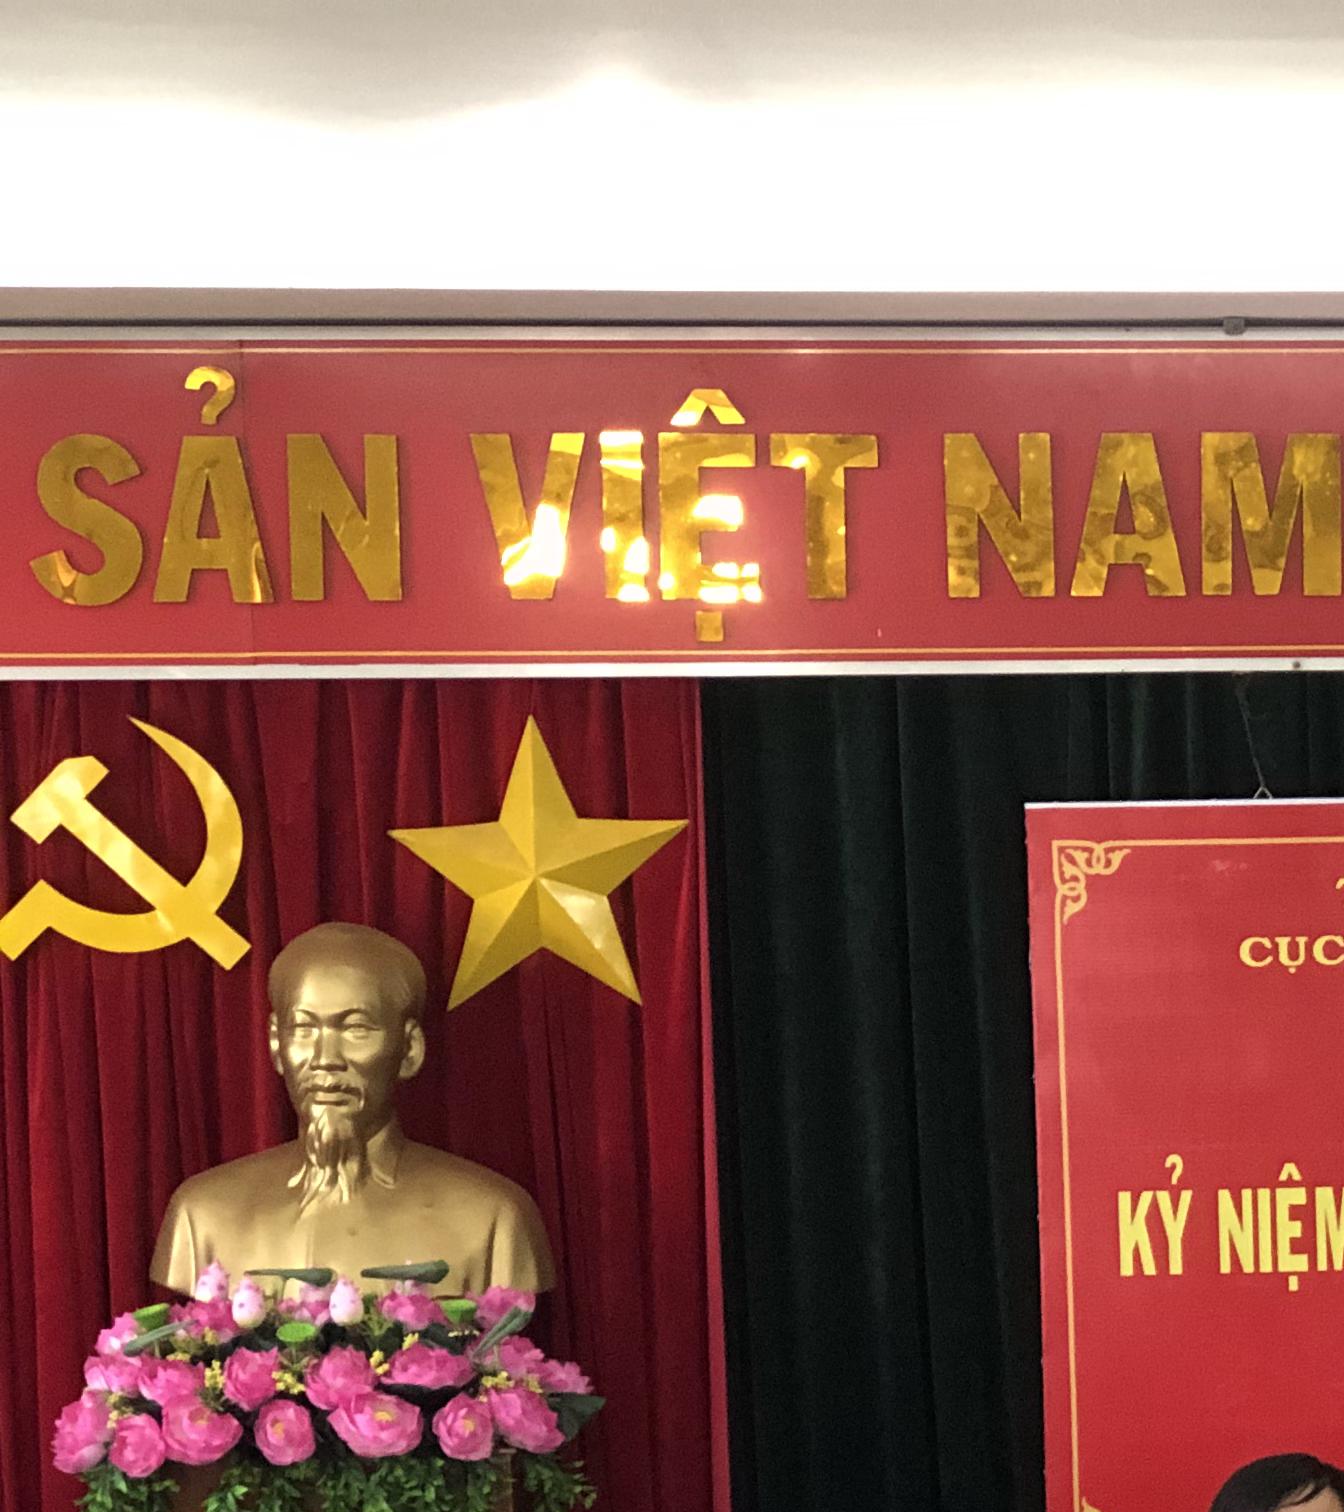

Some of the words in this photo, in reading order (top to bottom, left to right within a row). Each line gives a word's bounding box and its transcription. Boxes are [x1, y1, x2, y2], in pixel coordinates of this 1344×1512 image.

[28, 364, 404, 606] SẢN
[468, 387, 880, 643] VIỆT
[943, 431, 1343, 599] NAM
[1118, 1154, 1193, 1277] KỶ
